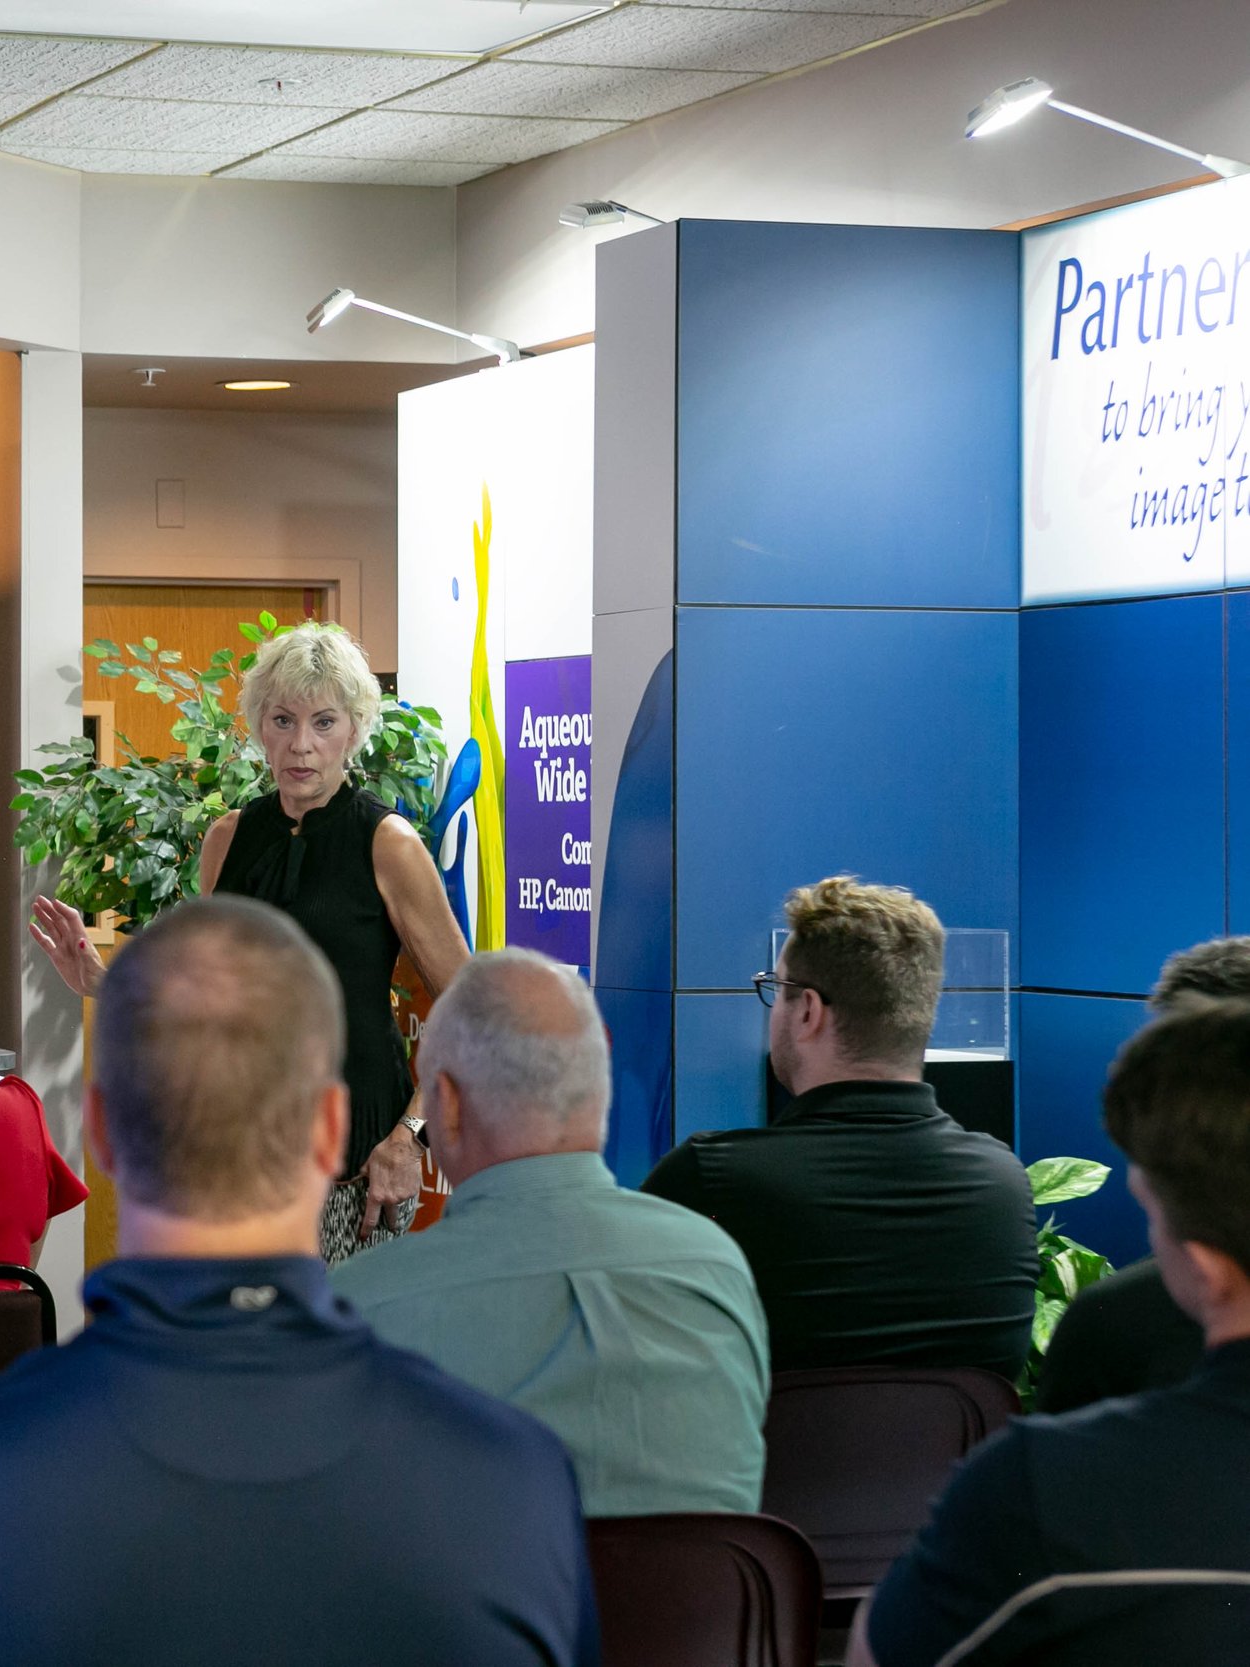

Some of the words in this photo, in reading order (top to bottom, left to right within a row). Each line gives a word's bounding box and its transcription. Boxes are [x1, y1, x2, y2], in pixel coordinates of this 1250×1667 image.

[1101, 380, 1129, 443] to
[1138, 361, 1222, 466] bring
[1130, 466, 1226, 562] image
[1234, 452, 1250, 519] t
[534, 756, 587, 802] Wide
[519, 877, 544, 914] HP,
[545, 878, 592, 912] Canon
